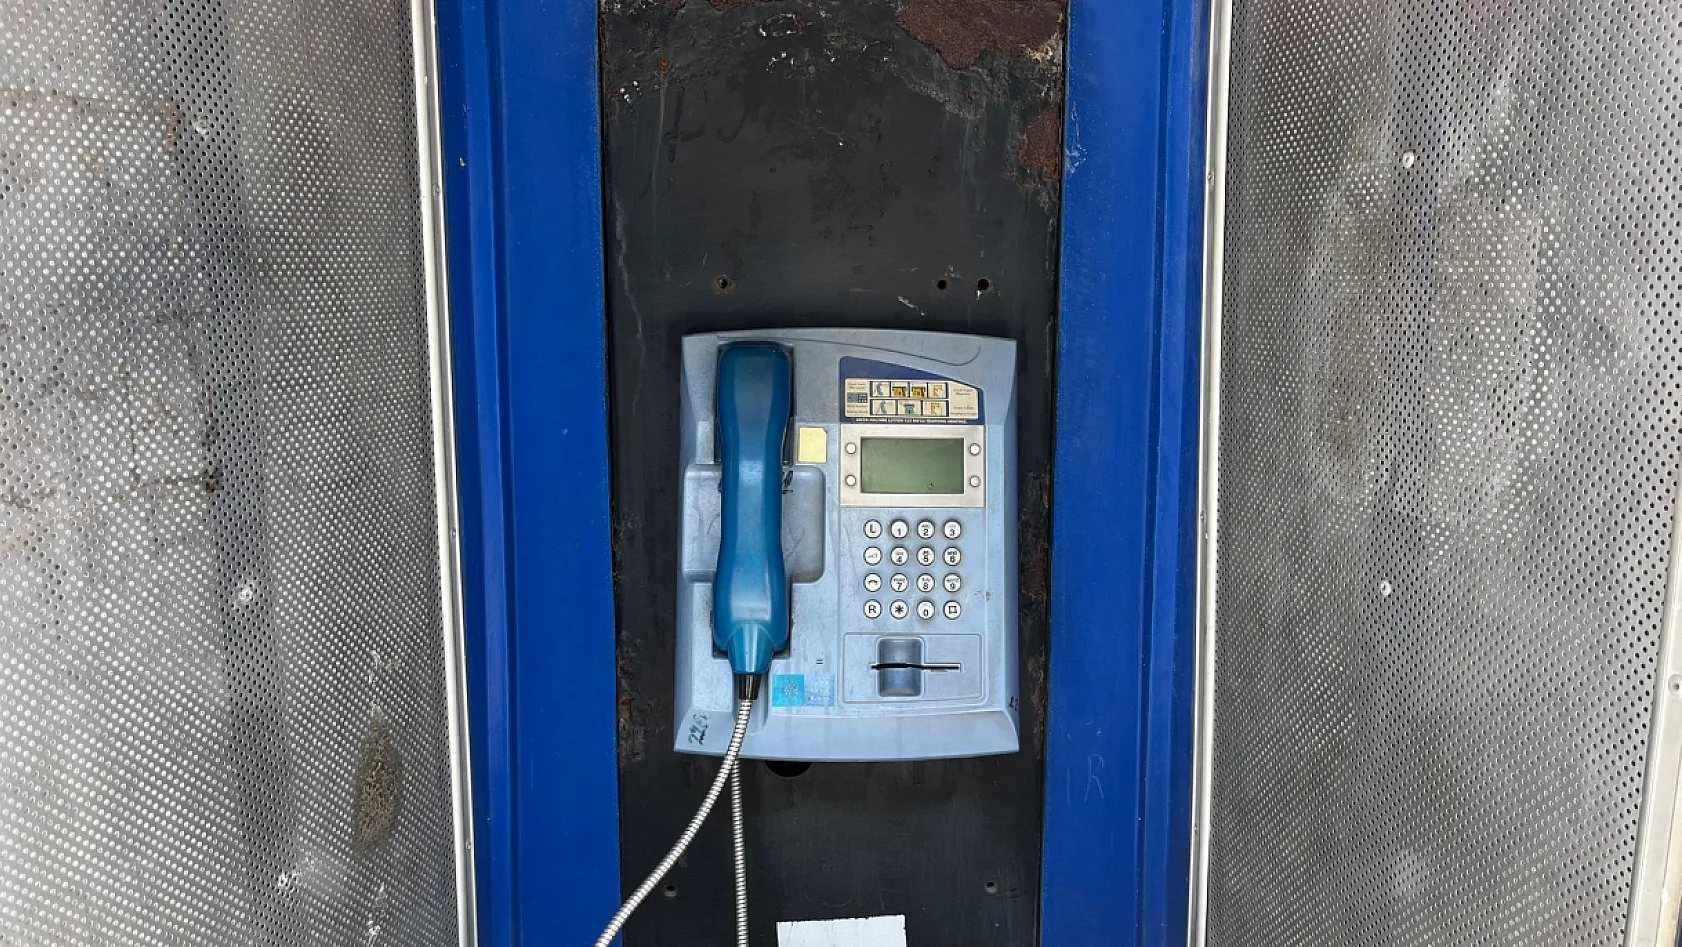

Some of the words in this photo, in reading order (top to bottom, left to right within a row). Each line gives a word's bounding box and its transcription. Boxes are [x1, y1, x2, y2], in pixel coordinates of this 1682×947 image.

[869, 524, 876, 533] L
[923, 528, 929, 536] 2
[949, 528, 955, 536] 3
[896, 555, 902, 563] 4
[923, 555, 929, 563] 5
[949, 555, 955, 564] 6
[897, 582, 902, 590] 7
[922, 582, 928, 590] 8
[949, 582, 955, 590] 9
[868, 605, 877, 614] R
[923, 609, 928, 617] 0
